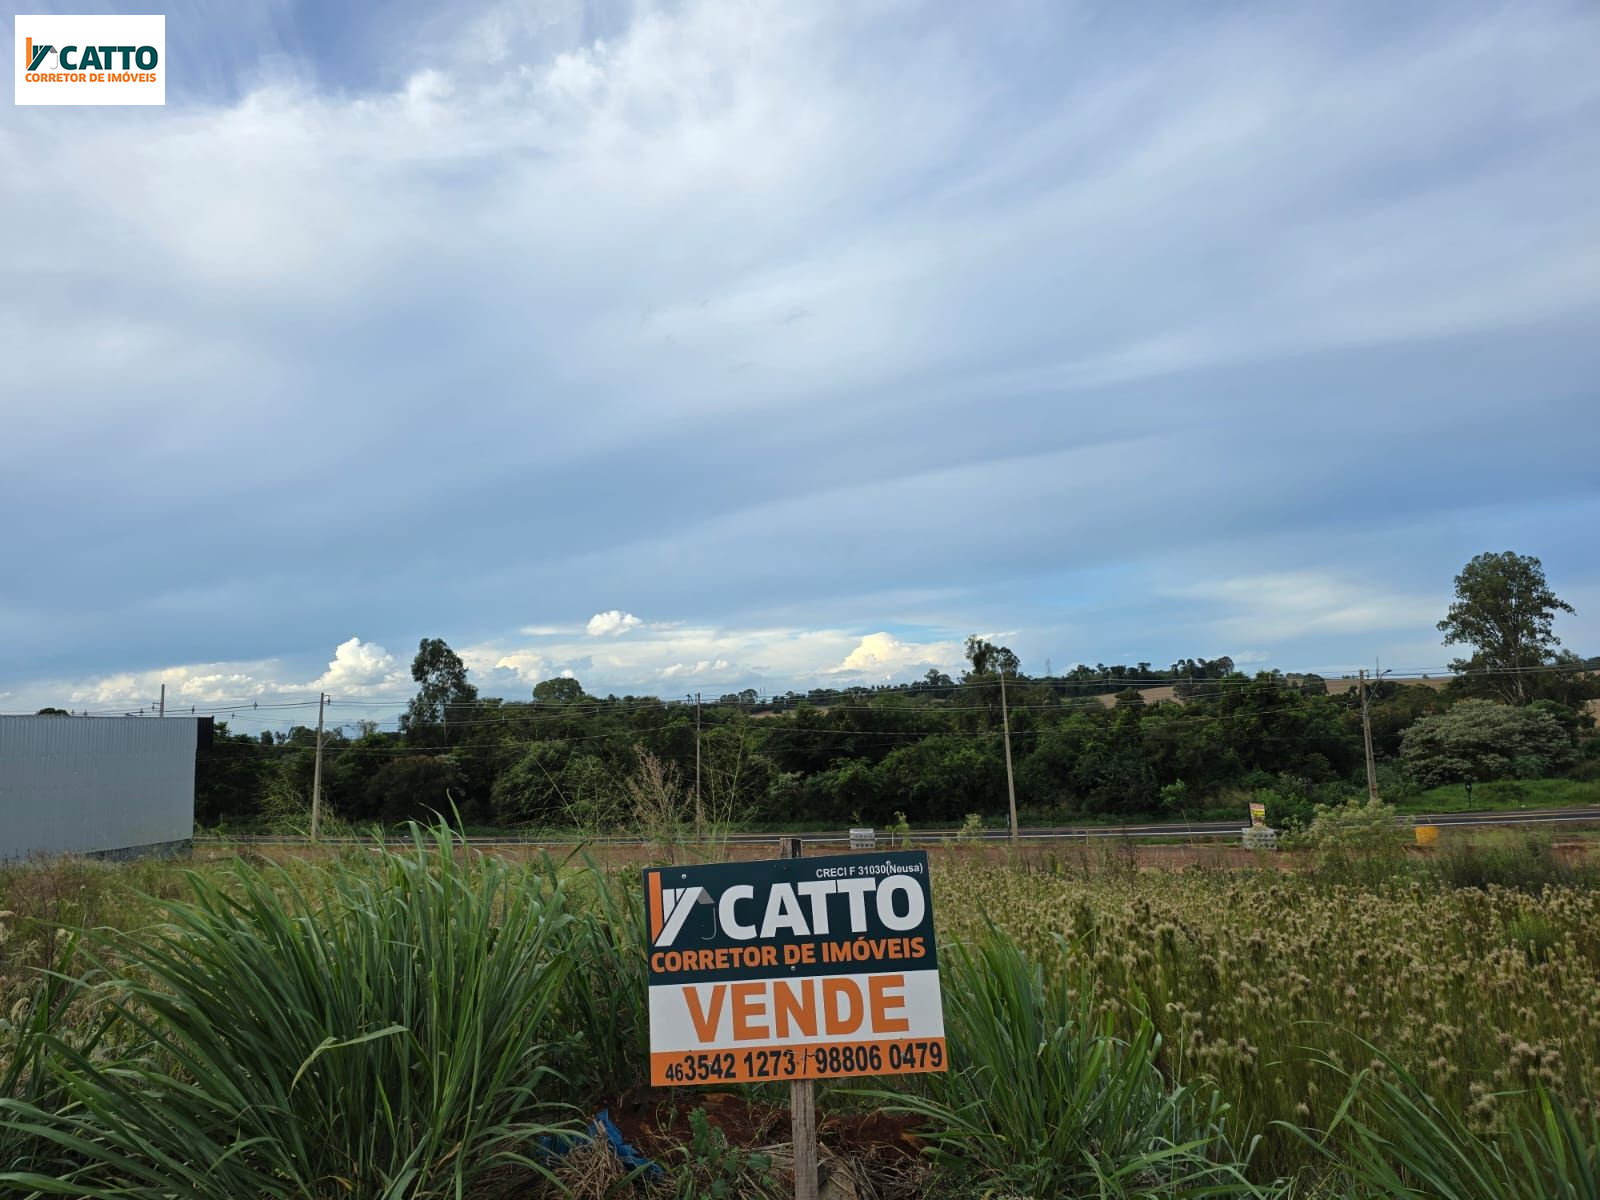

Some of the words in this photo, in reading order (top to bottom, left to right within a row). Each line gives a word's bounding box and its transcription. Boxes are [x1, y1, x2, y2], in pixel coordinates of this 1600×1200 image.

[816, 867, 847, 878] CRECI
[849, 866, 856, 876] F
[718, 874, 925, 941] CATTO
[651, 946, 779, 973] CORRETOR
[783, 943, 817, 965] DE
[821, 936, 926, 963] IMÓVEIS
[682, 974, 910, 1043] VENDE
[743, 1049, 796, 1077] 1273
[815, 1044, 882, 1074] 98806
[888, 1041, 943, 1070] 0479
